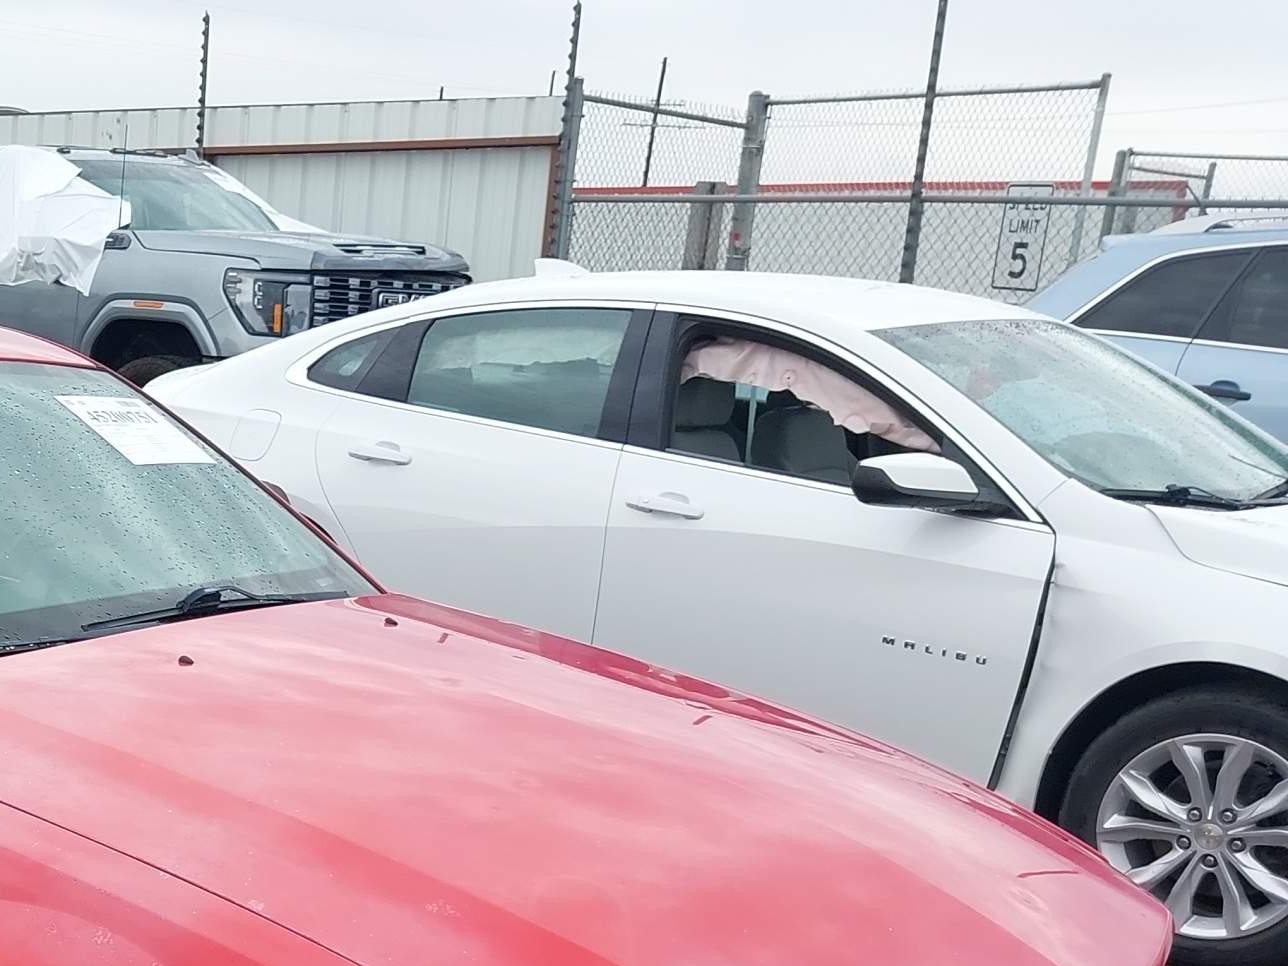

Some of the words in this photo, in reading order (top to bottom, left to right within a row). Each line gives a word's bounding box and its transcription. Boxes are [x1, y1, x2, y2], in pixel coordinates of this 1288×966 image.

[1008, 219, 1041, 233] LIMIT
[1007, 241, 1029, 280] 5
[881, 635, 988, 666] MALIBU
